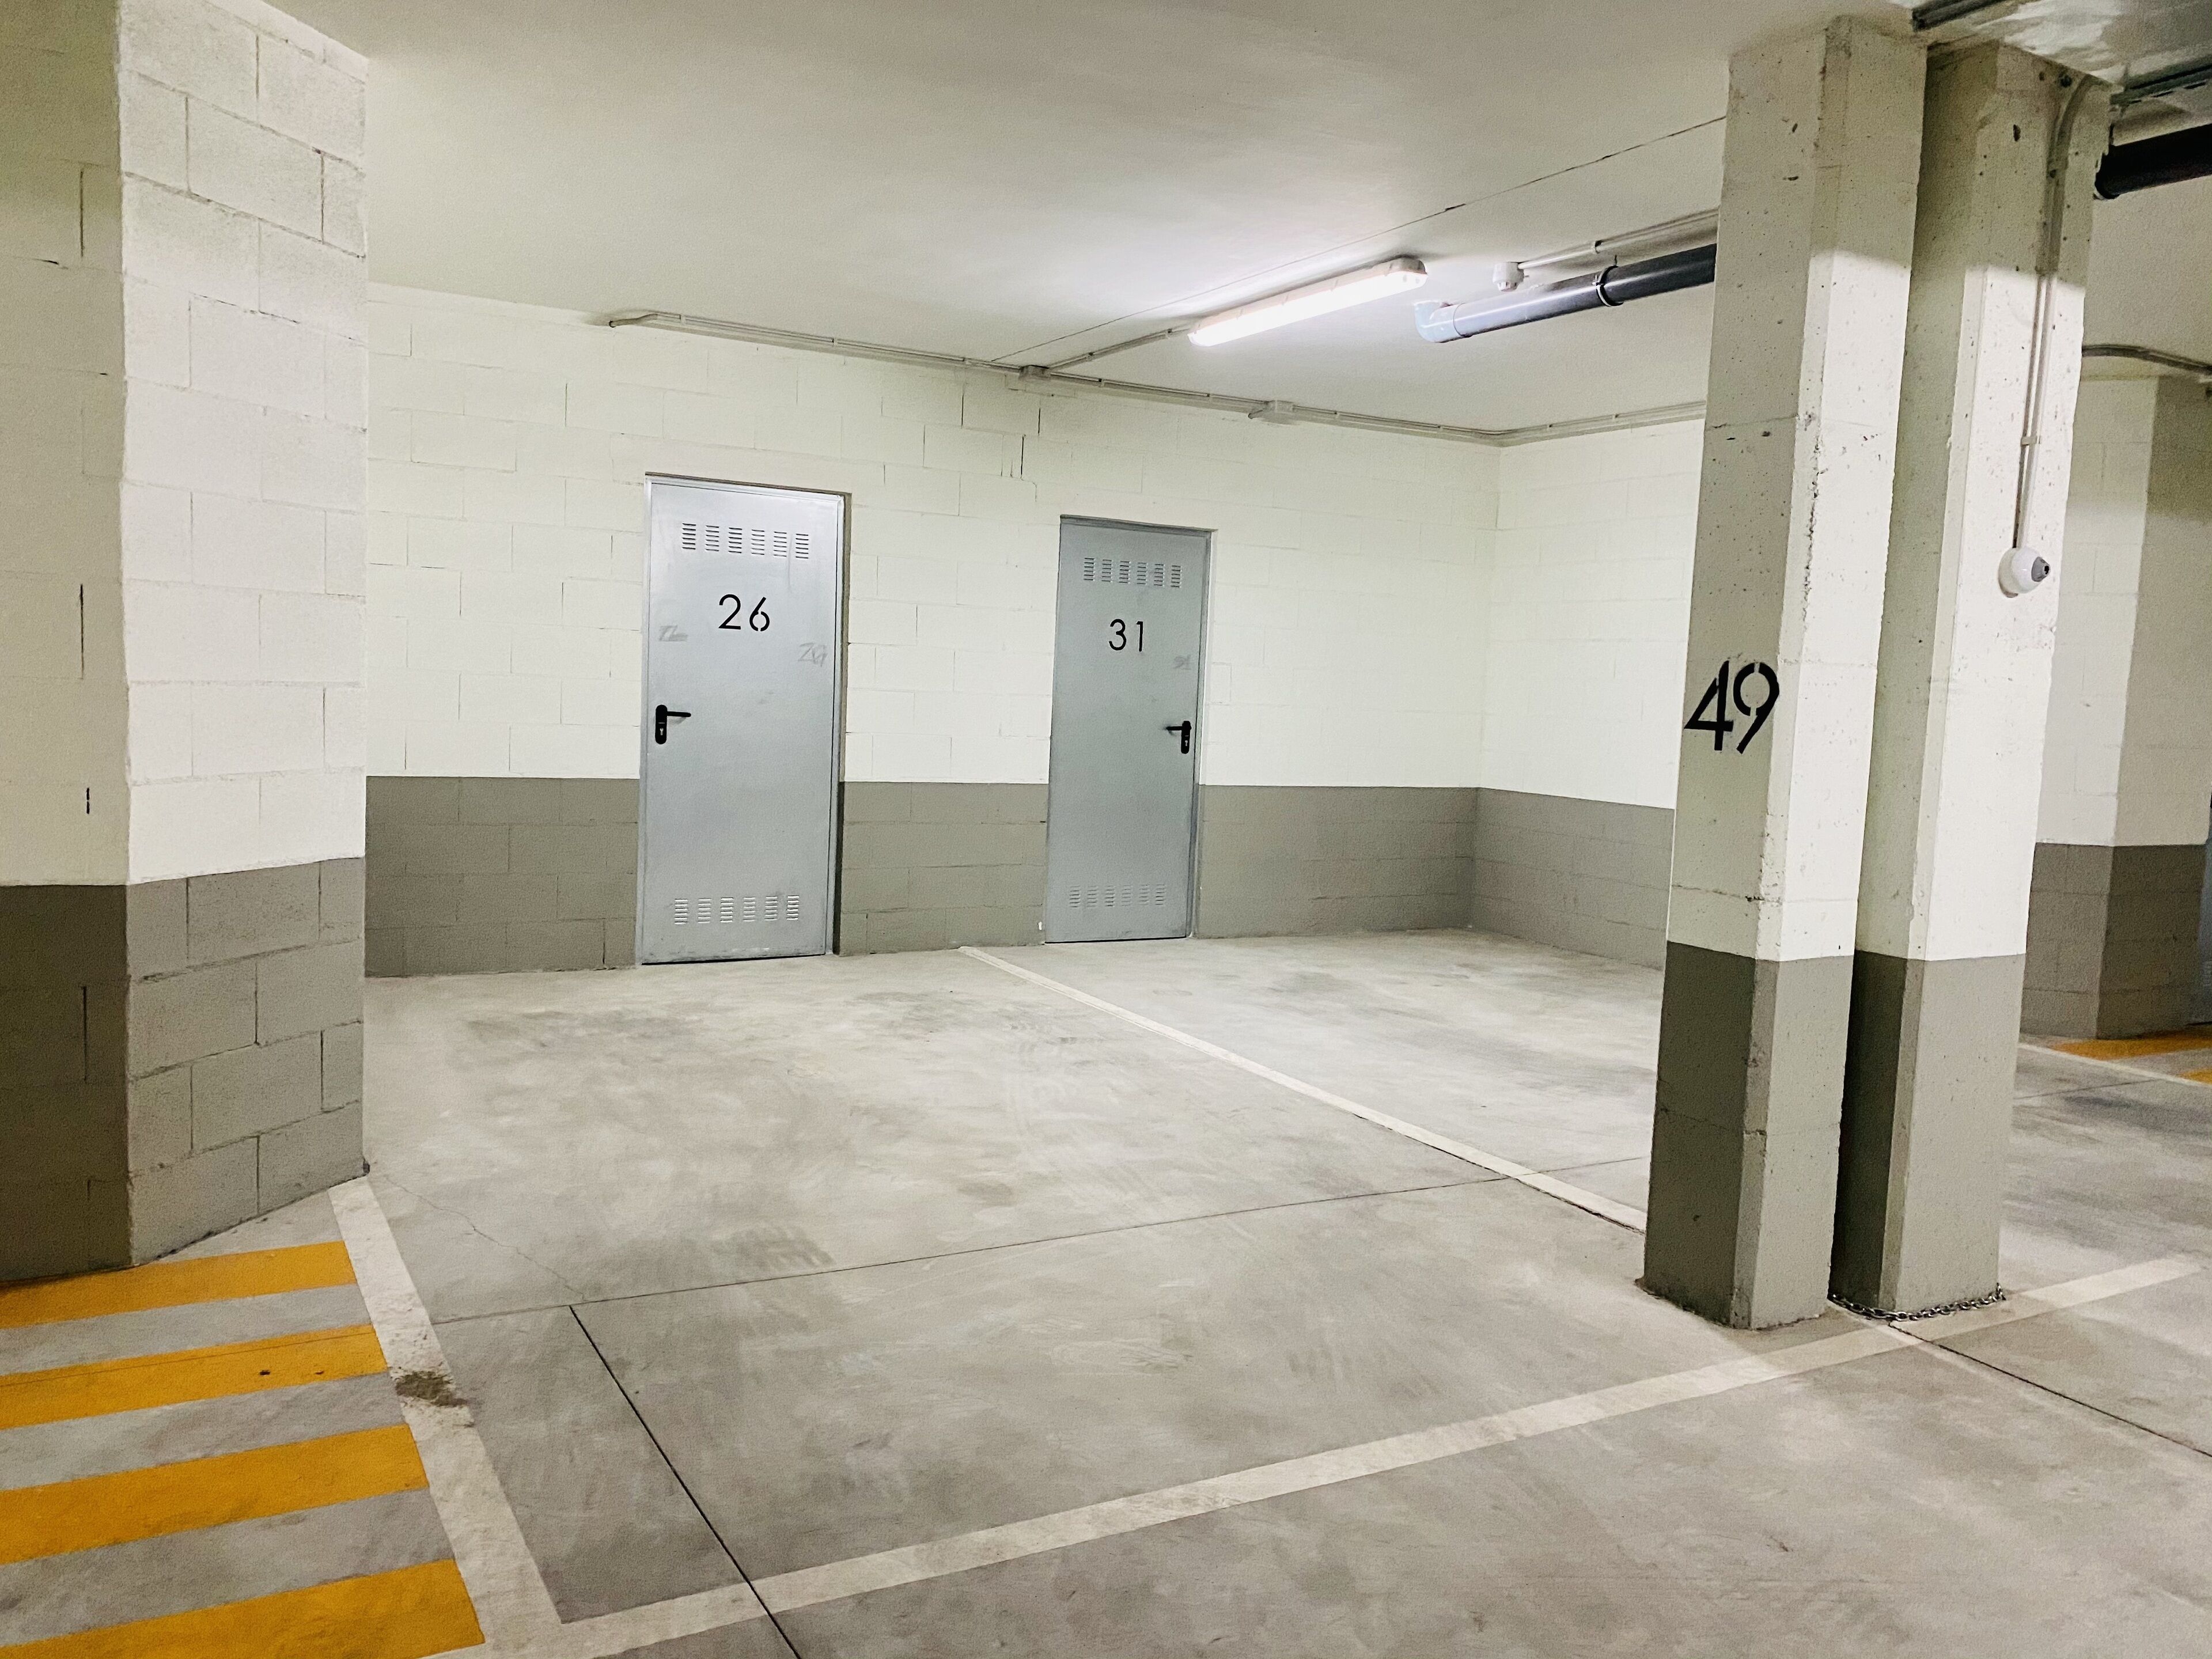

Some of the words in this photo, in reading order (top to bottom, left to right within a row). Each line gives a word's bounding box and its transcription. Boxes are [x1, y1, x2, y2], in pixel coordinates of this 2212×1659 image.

[718, 594, 770, 632] 26
[1108, 619, 1143, 652] 31
[1683, 660, 1780, 755] 49
